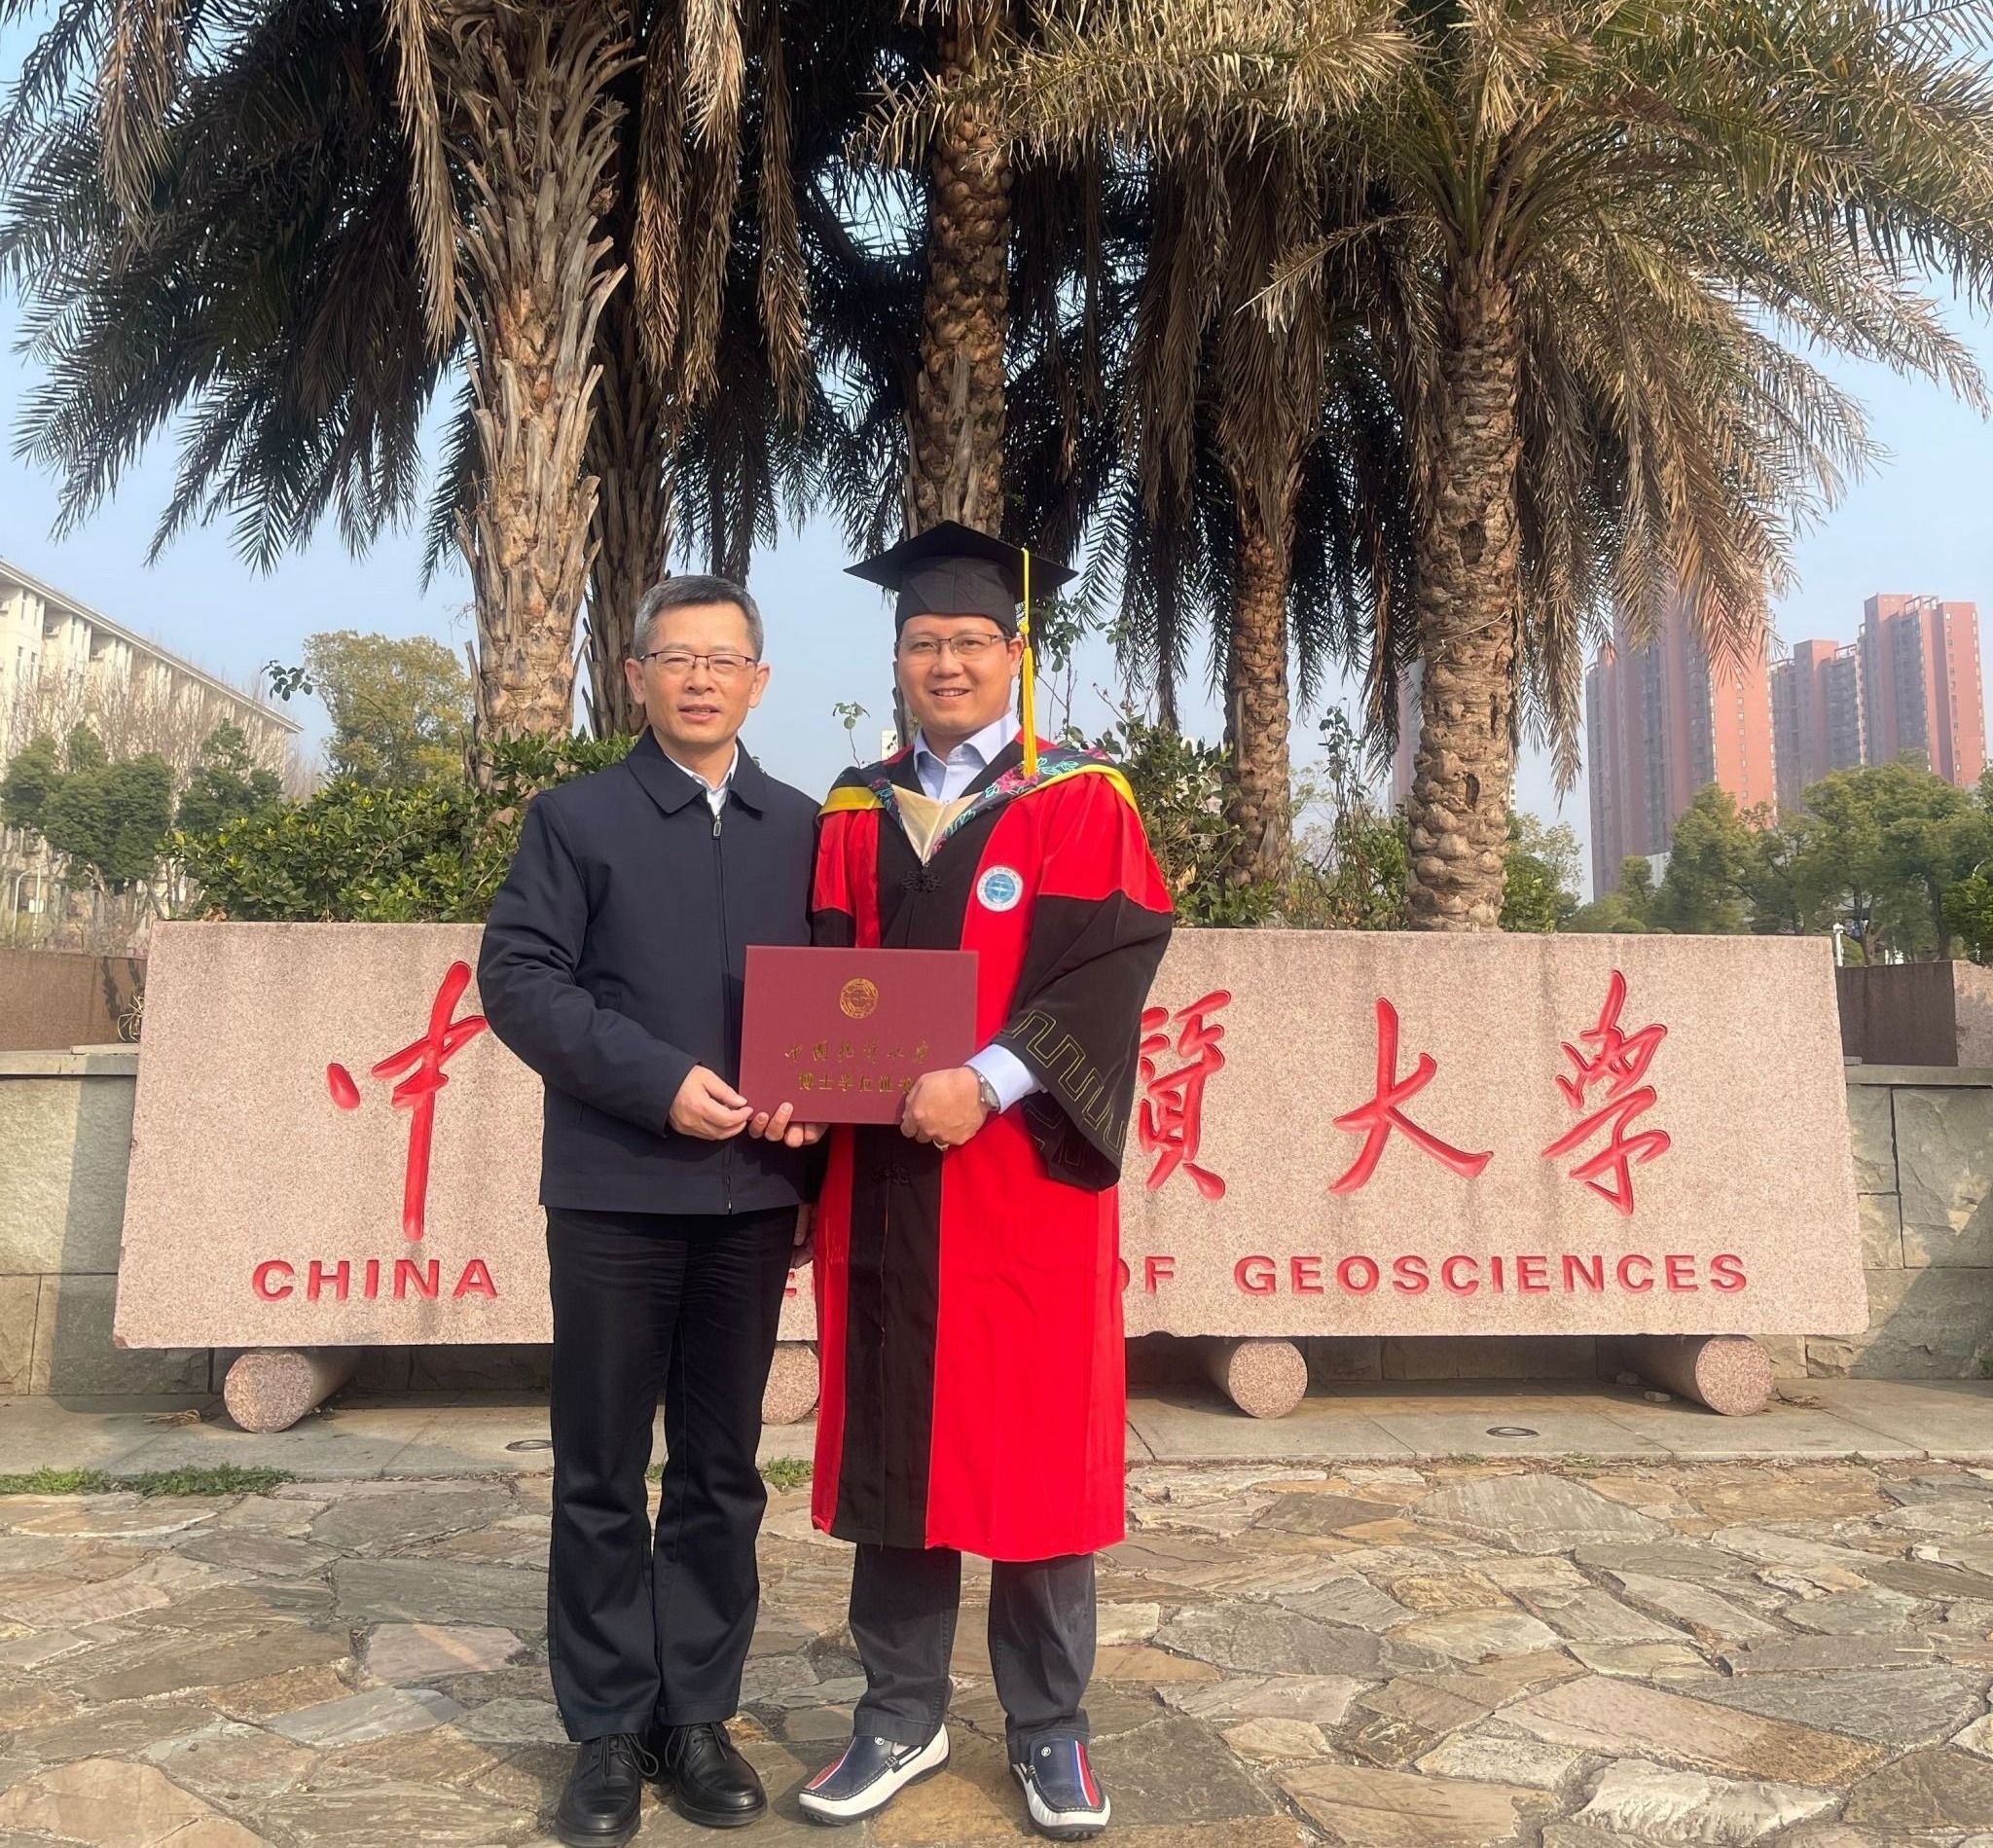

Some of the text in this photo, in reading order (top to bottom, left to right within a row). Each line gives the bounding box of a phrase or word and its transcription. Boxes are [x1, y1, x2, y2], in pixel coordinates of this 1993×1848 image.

[251, 1253, 1748, 1302] CHINA F GEOSCIENCES
